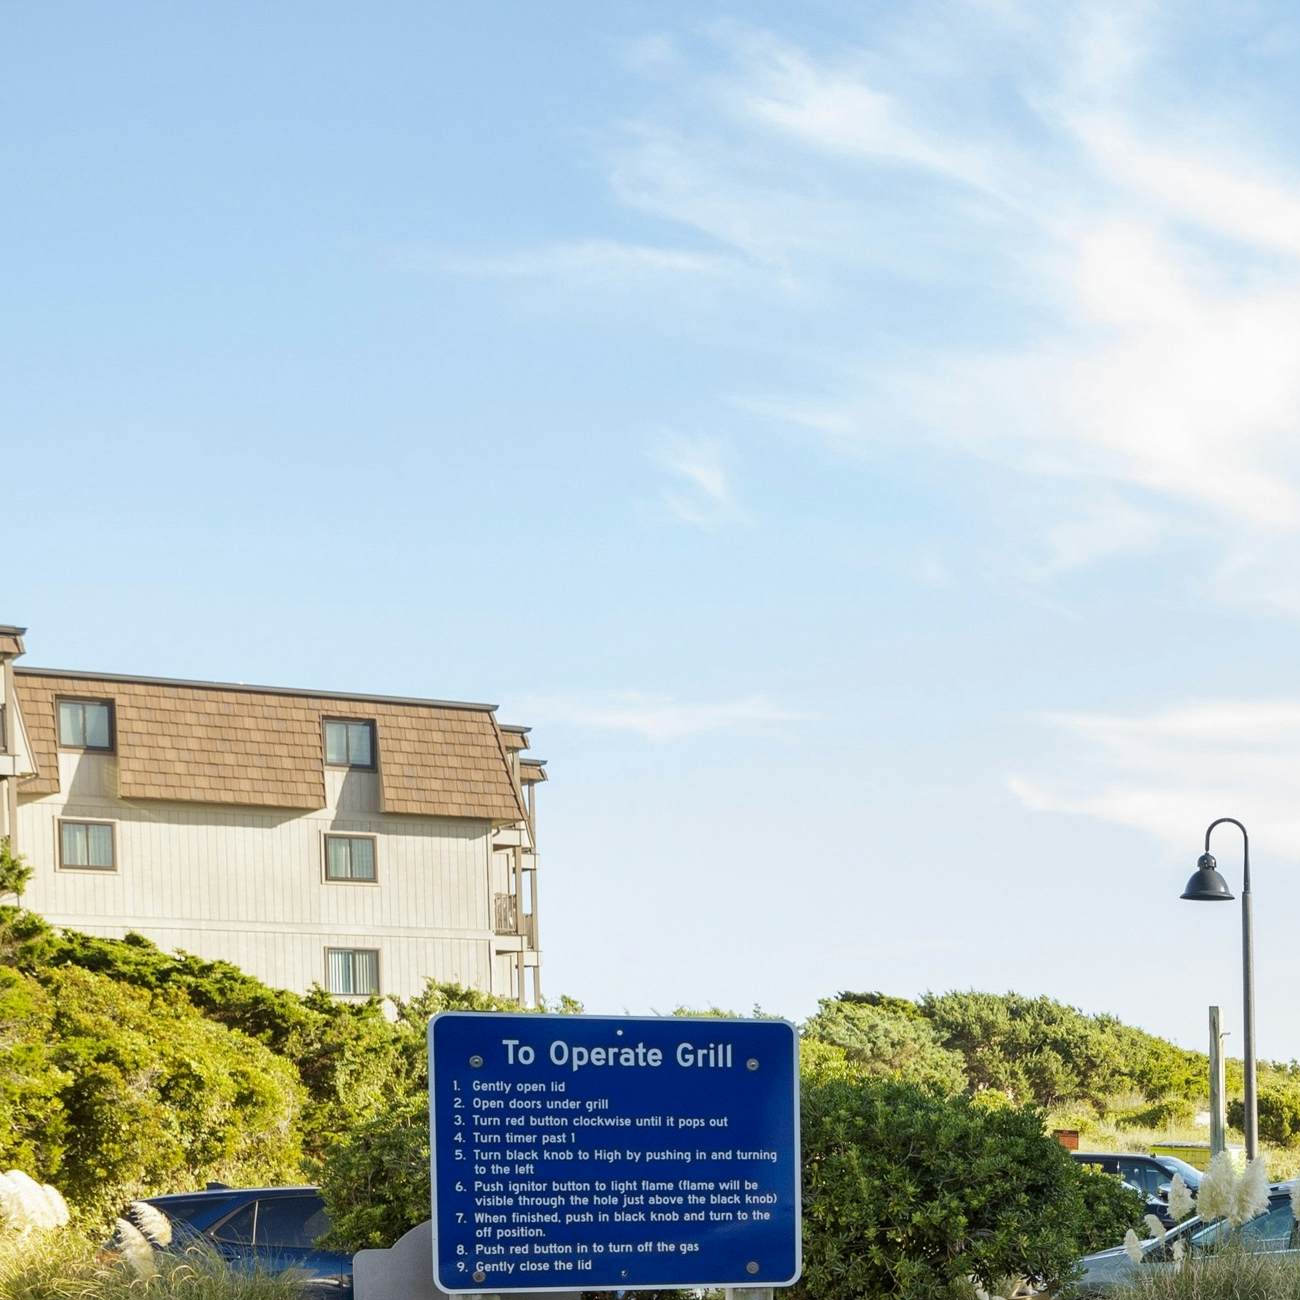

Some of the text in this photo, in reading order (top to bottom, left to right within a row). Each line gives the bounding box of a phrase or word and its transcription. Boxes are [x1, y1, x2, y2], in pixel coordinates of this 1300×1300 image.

[502, 1040, 731, 1071] To Operate Grill
[454, 1081, 565, 1093] 1. Gently open lid
[454, 1098, 608, 1112] 2. Open doors under grill
[454, 1115, 727, 1128] 3. Turn red button clockwise until it pops out
[454, 1132, 465, 1142] 4.
[473, 1132, 500, 1142] Turn
[506, 1133, 537, 1143] timer
[542, 1133, 566, 1145] past
[455, 1150, 777, 1163] 5. Turn black knob to High by pushing in and turning
[475, 1164, 533, 1174] to the left
[456, 1180, 758, 1194] 6. Push ignitor button to light flame (flame will be
[475, 1193, 777, 1208] visible through the hole just above the black knob)
[456, 1213, 466, 1223] 7.
[475, 1213, 506, 1223] When
[566, 1212, 593, 1224] push
[599, 1212, 609, 1221] in
[614, 1212, 645, 1221] black
[651, 1211, 679, 1221] knob
[684, 1211, 704, 1221] and
[709, 1211, 732, 1220] turn
[737, 1211, 748, 1220] to
[752, 1210, 770, 1220] the
[476, 1227, 545, 1239] off position.
[457, 1242, 699, 1255] 8. Push red button in to turn off the gas
[457, 1260, 591, 1275] 9. Gently close the lid
